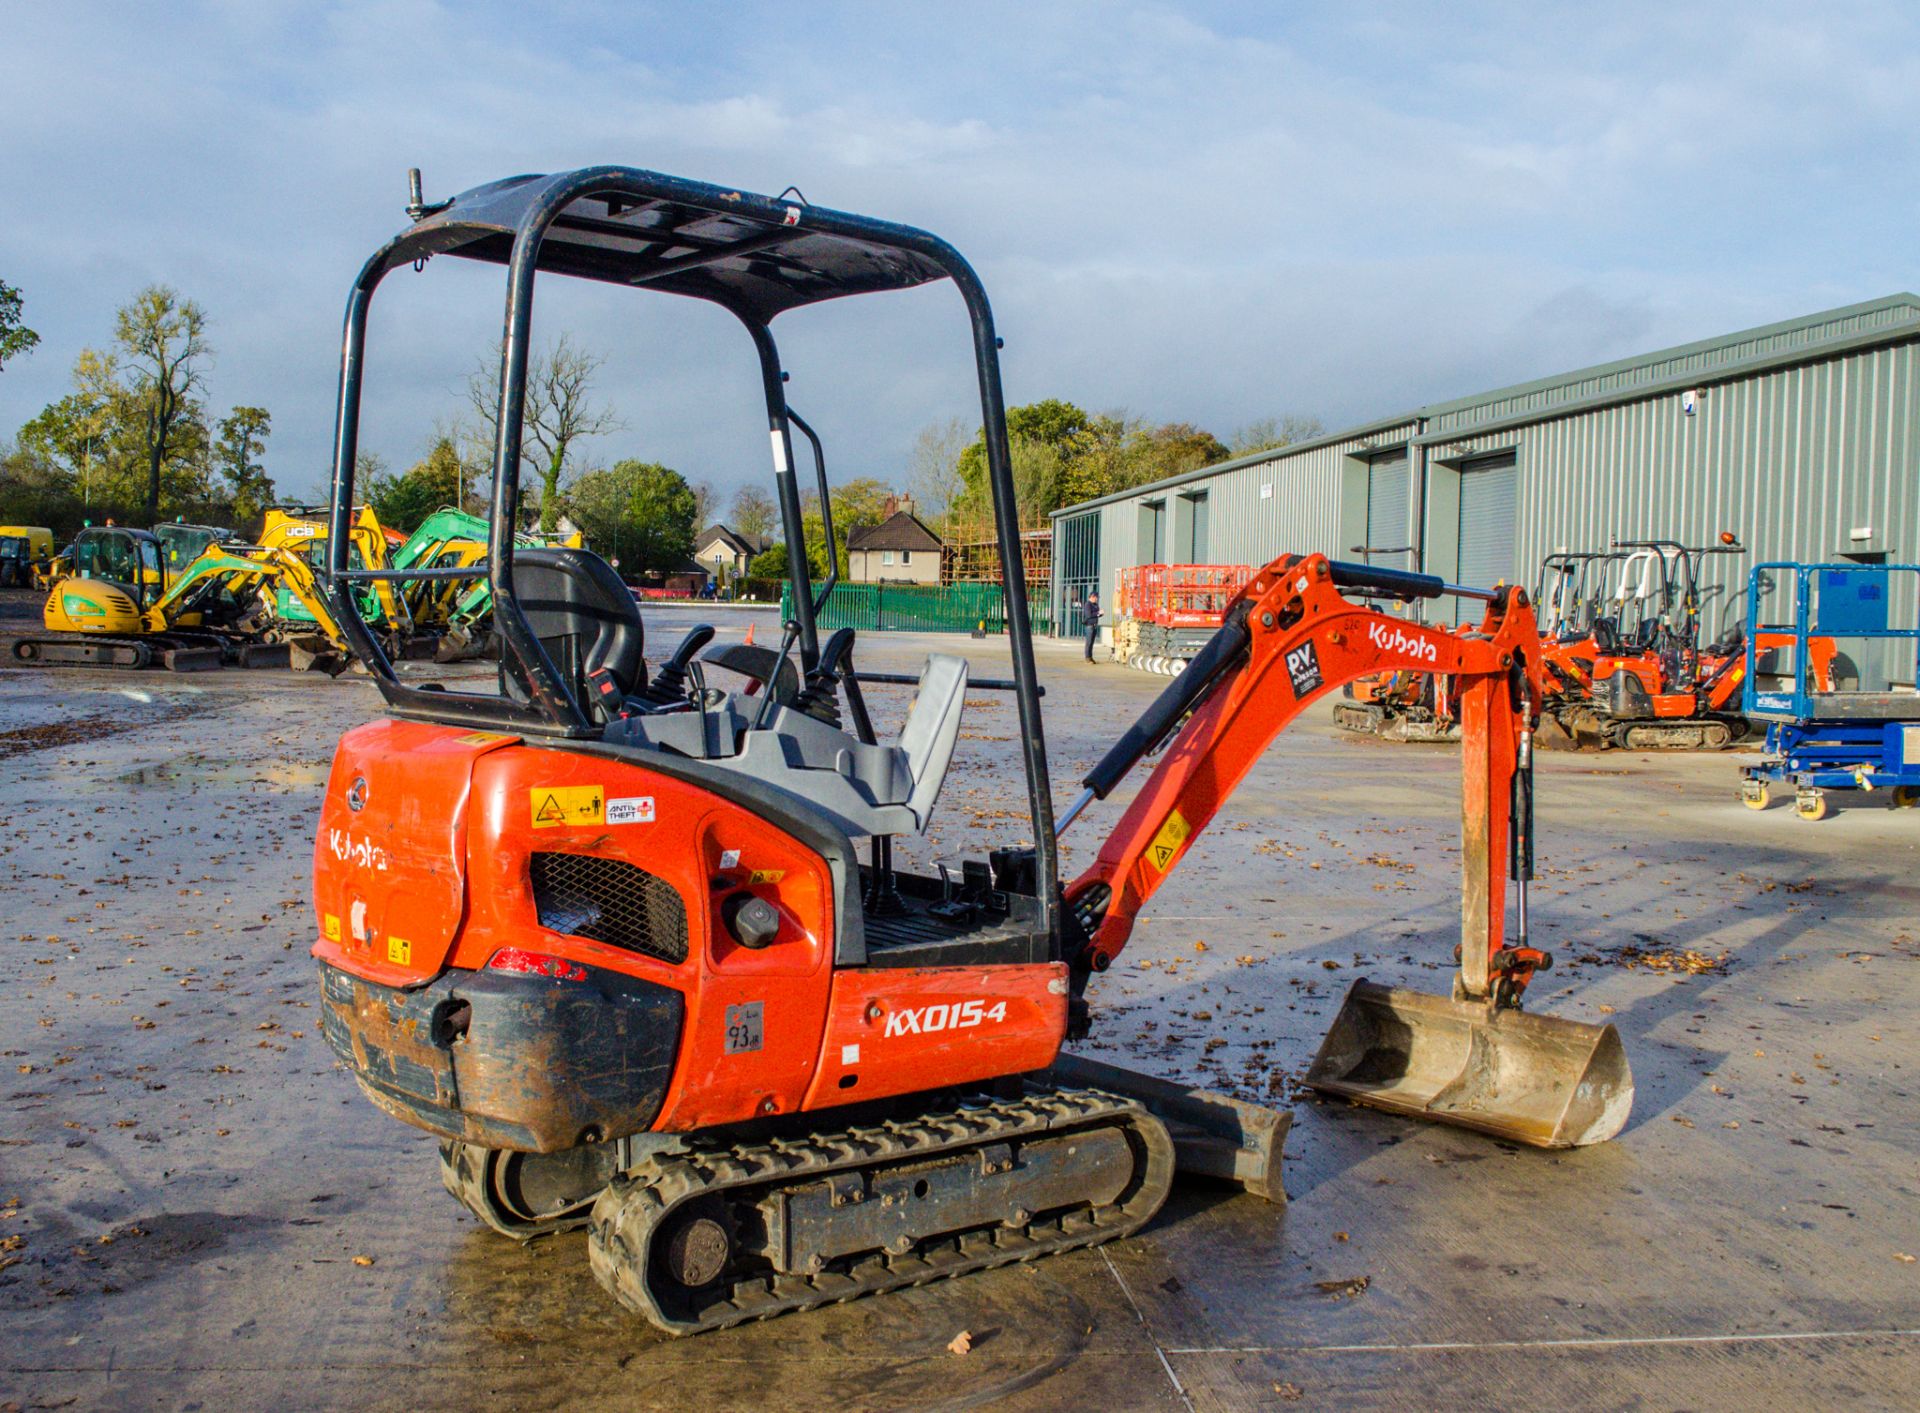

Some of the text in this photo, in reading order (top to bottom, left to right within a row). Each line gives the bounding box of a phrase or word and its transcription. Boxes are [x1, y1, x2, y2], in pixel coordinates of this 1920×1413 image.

[286, 527, 314, 536] JCB
[1369, 622, 1437, 662] Kubota
[608, 811, 636, 819] THEFT
[884, 999, 1007, 1038] KX015-4
